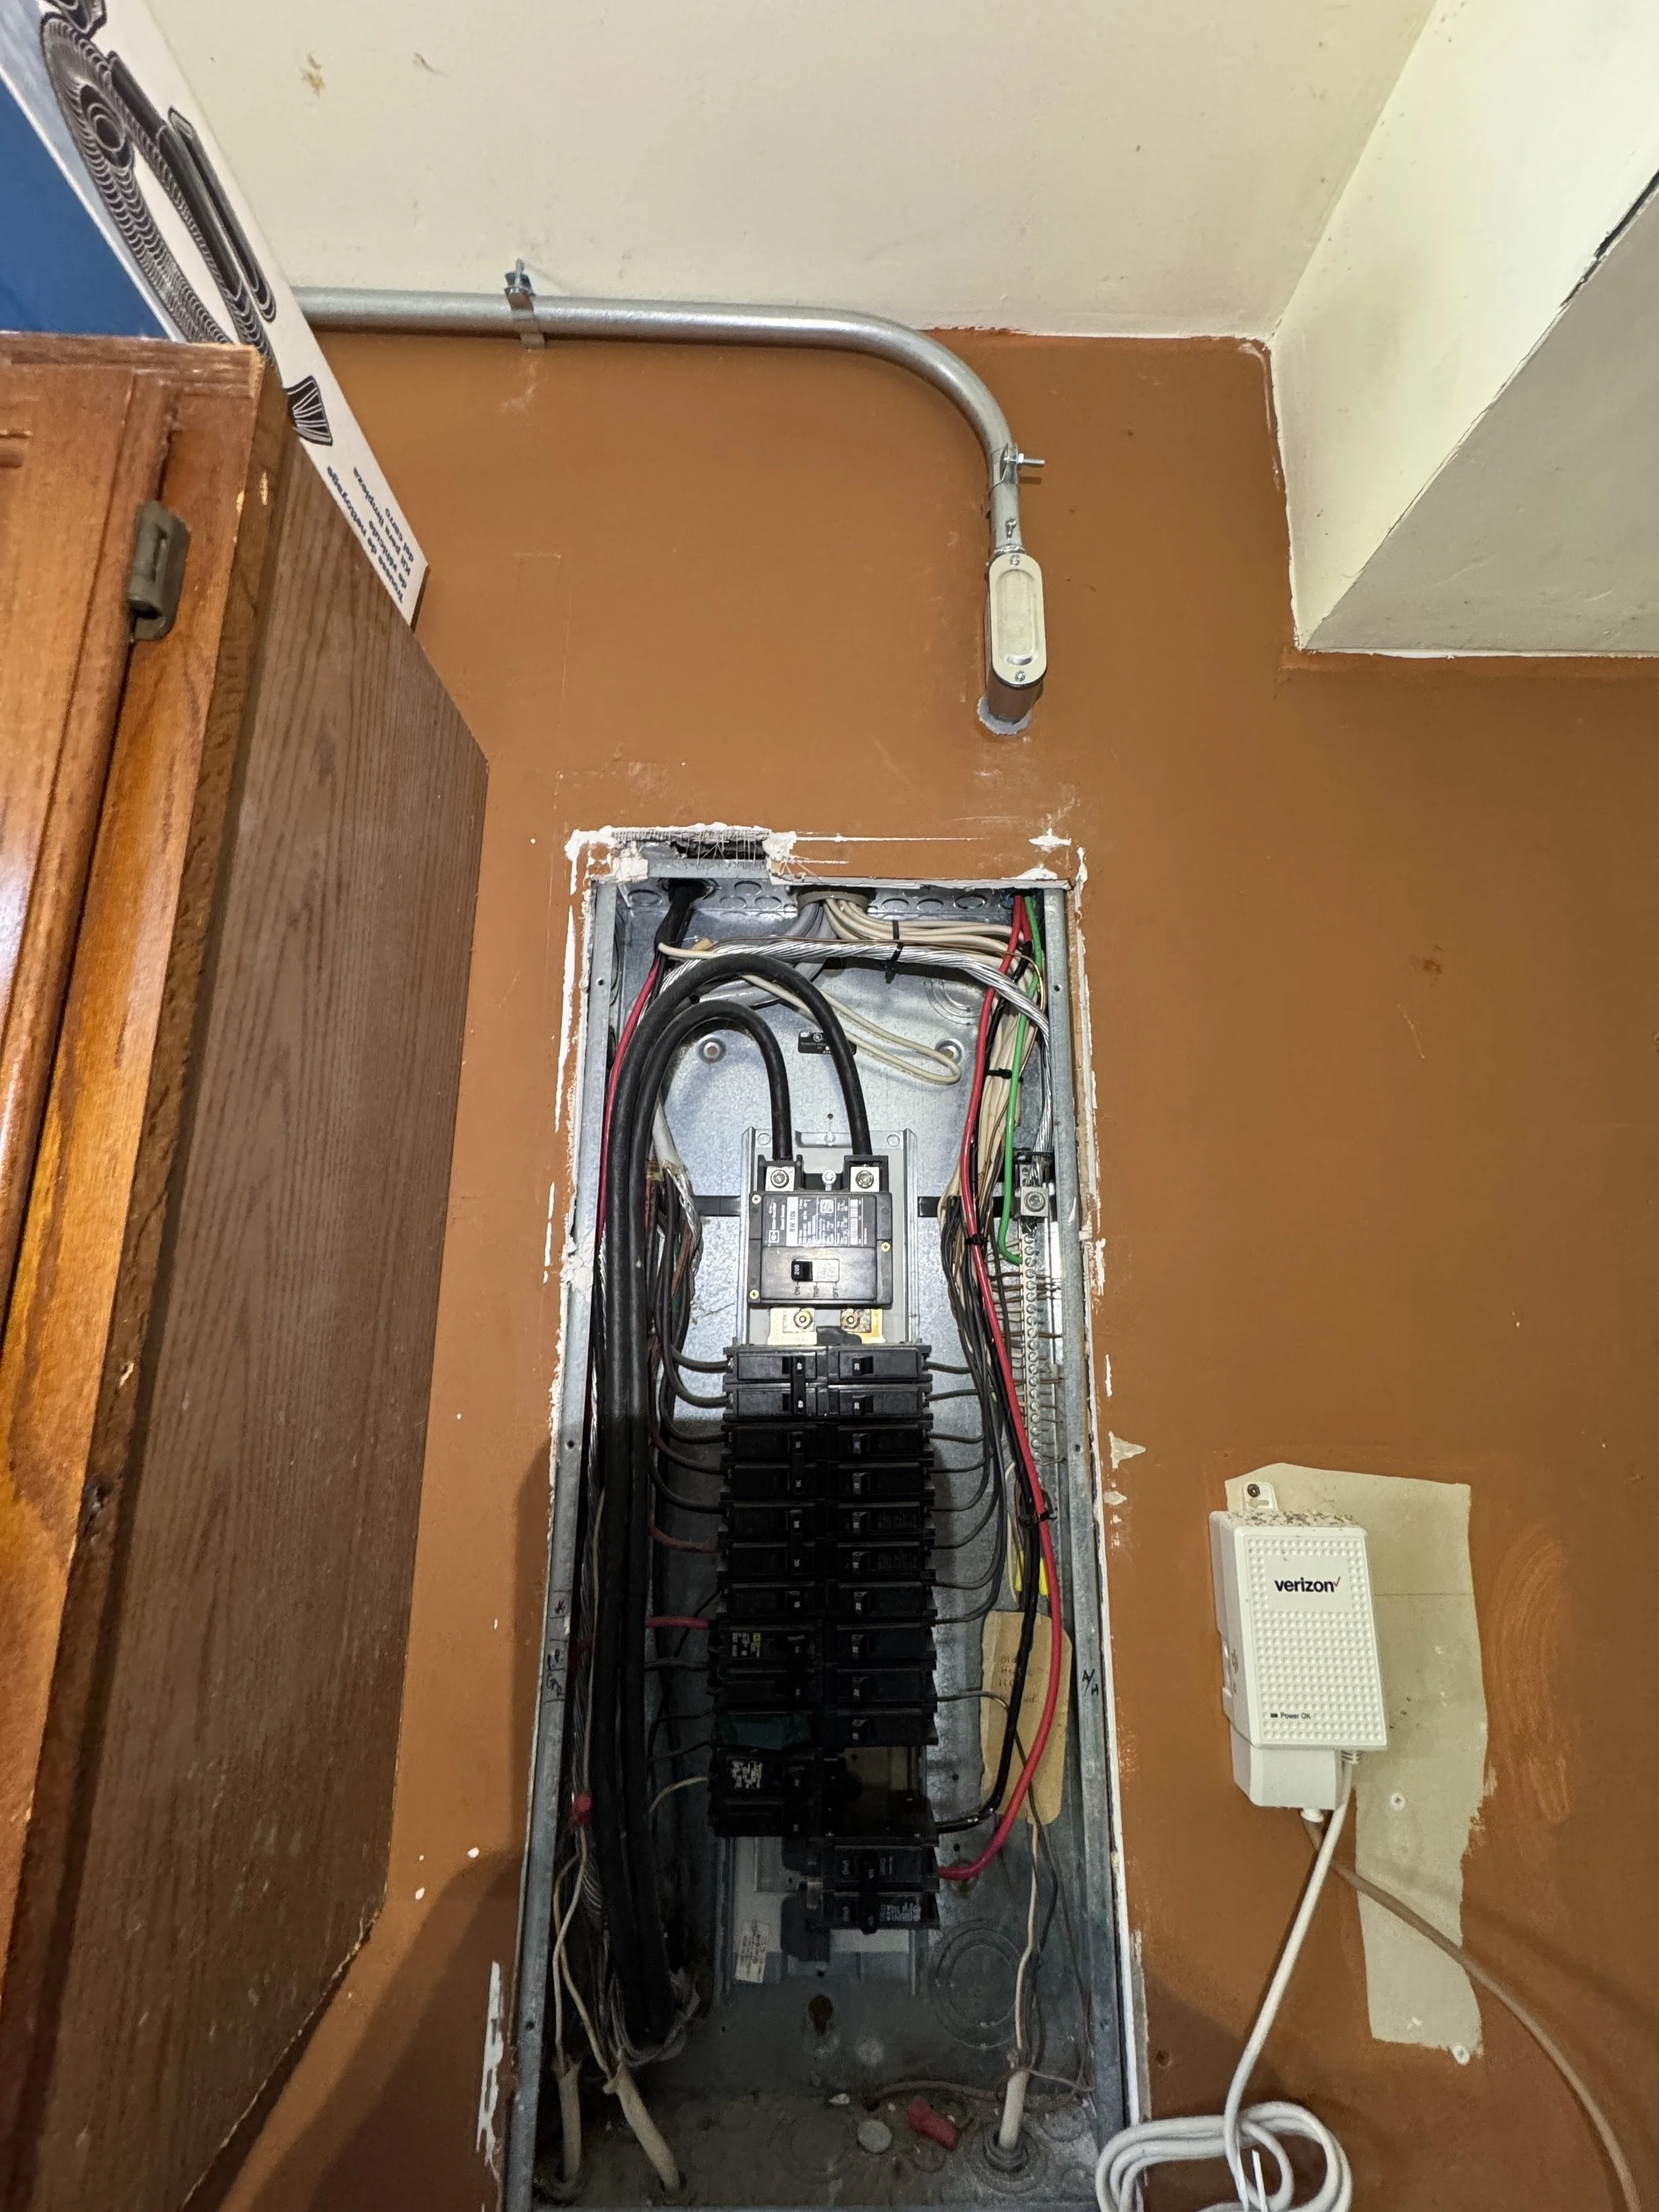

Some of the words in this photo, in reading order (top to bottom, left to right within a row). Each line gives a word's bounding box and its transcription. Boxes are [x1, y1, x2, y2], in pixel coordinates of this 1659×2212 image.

[326, 465, 366, 537] nettoyage
[352, 467, 384, 528] limpieza
[385, 508, 403, 542] carro
[368, 537, 377, 555] de
[385, 525, 401, 555] para
[403, 542, 414, 563] del
[401, 555, 411, 576] Kit
[378, 555, 403, 604] Trousse
[398, 572, 407, 589] de
[794, 1286, 801, 1296] ON
[1274, 1577, 1334, 1593] verizon
